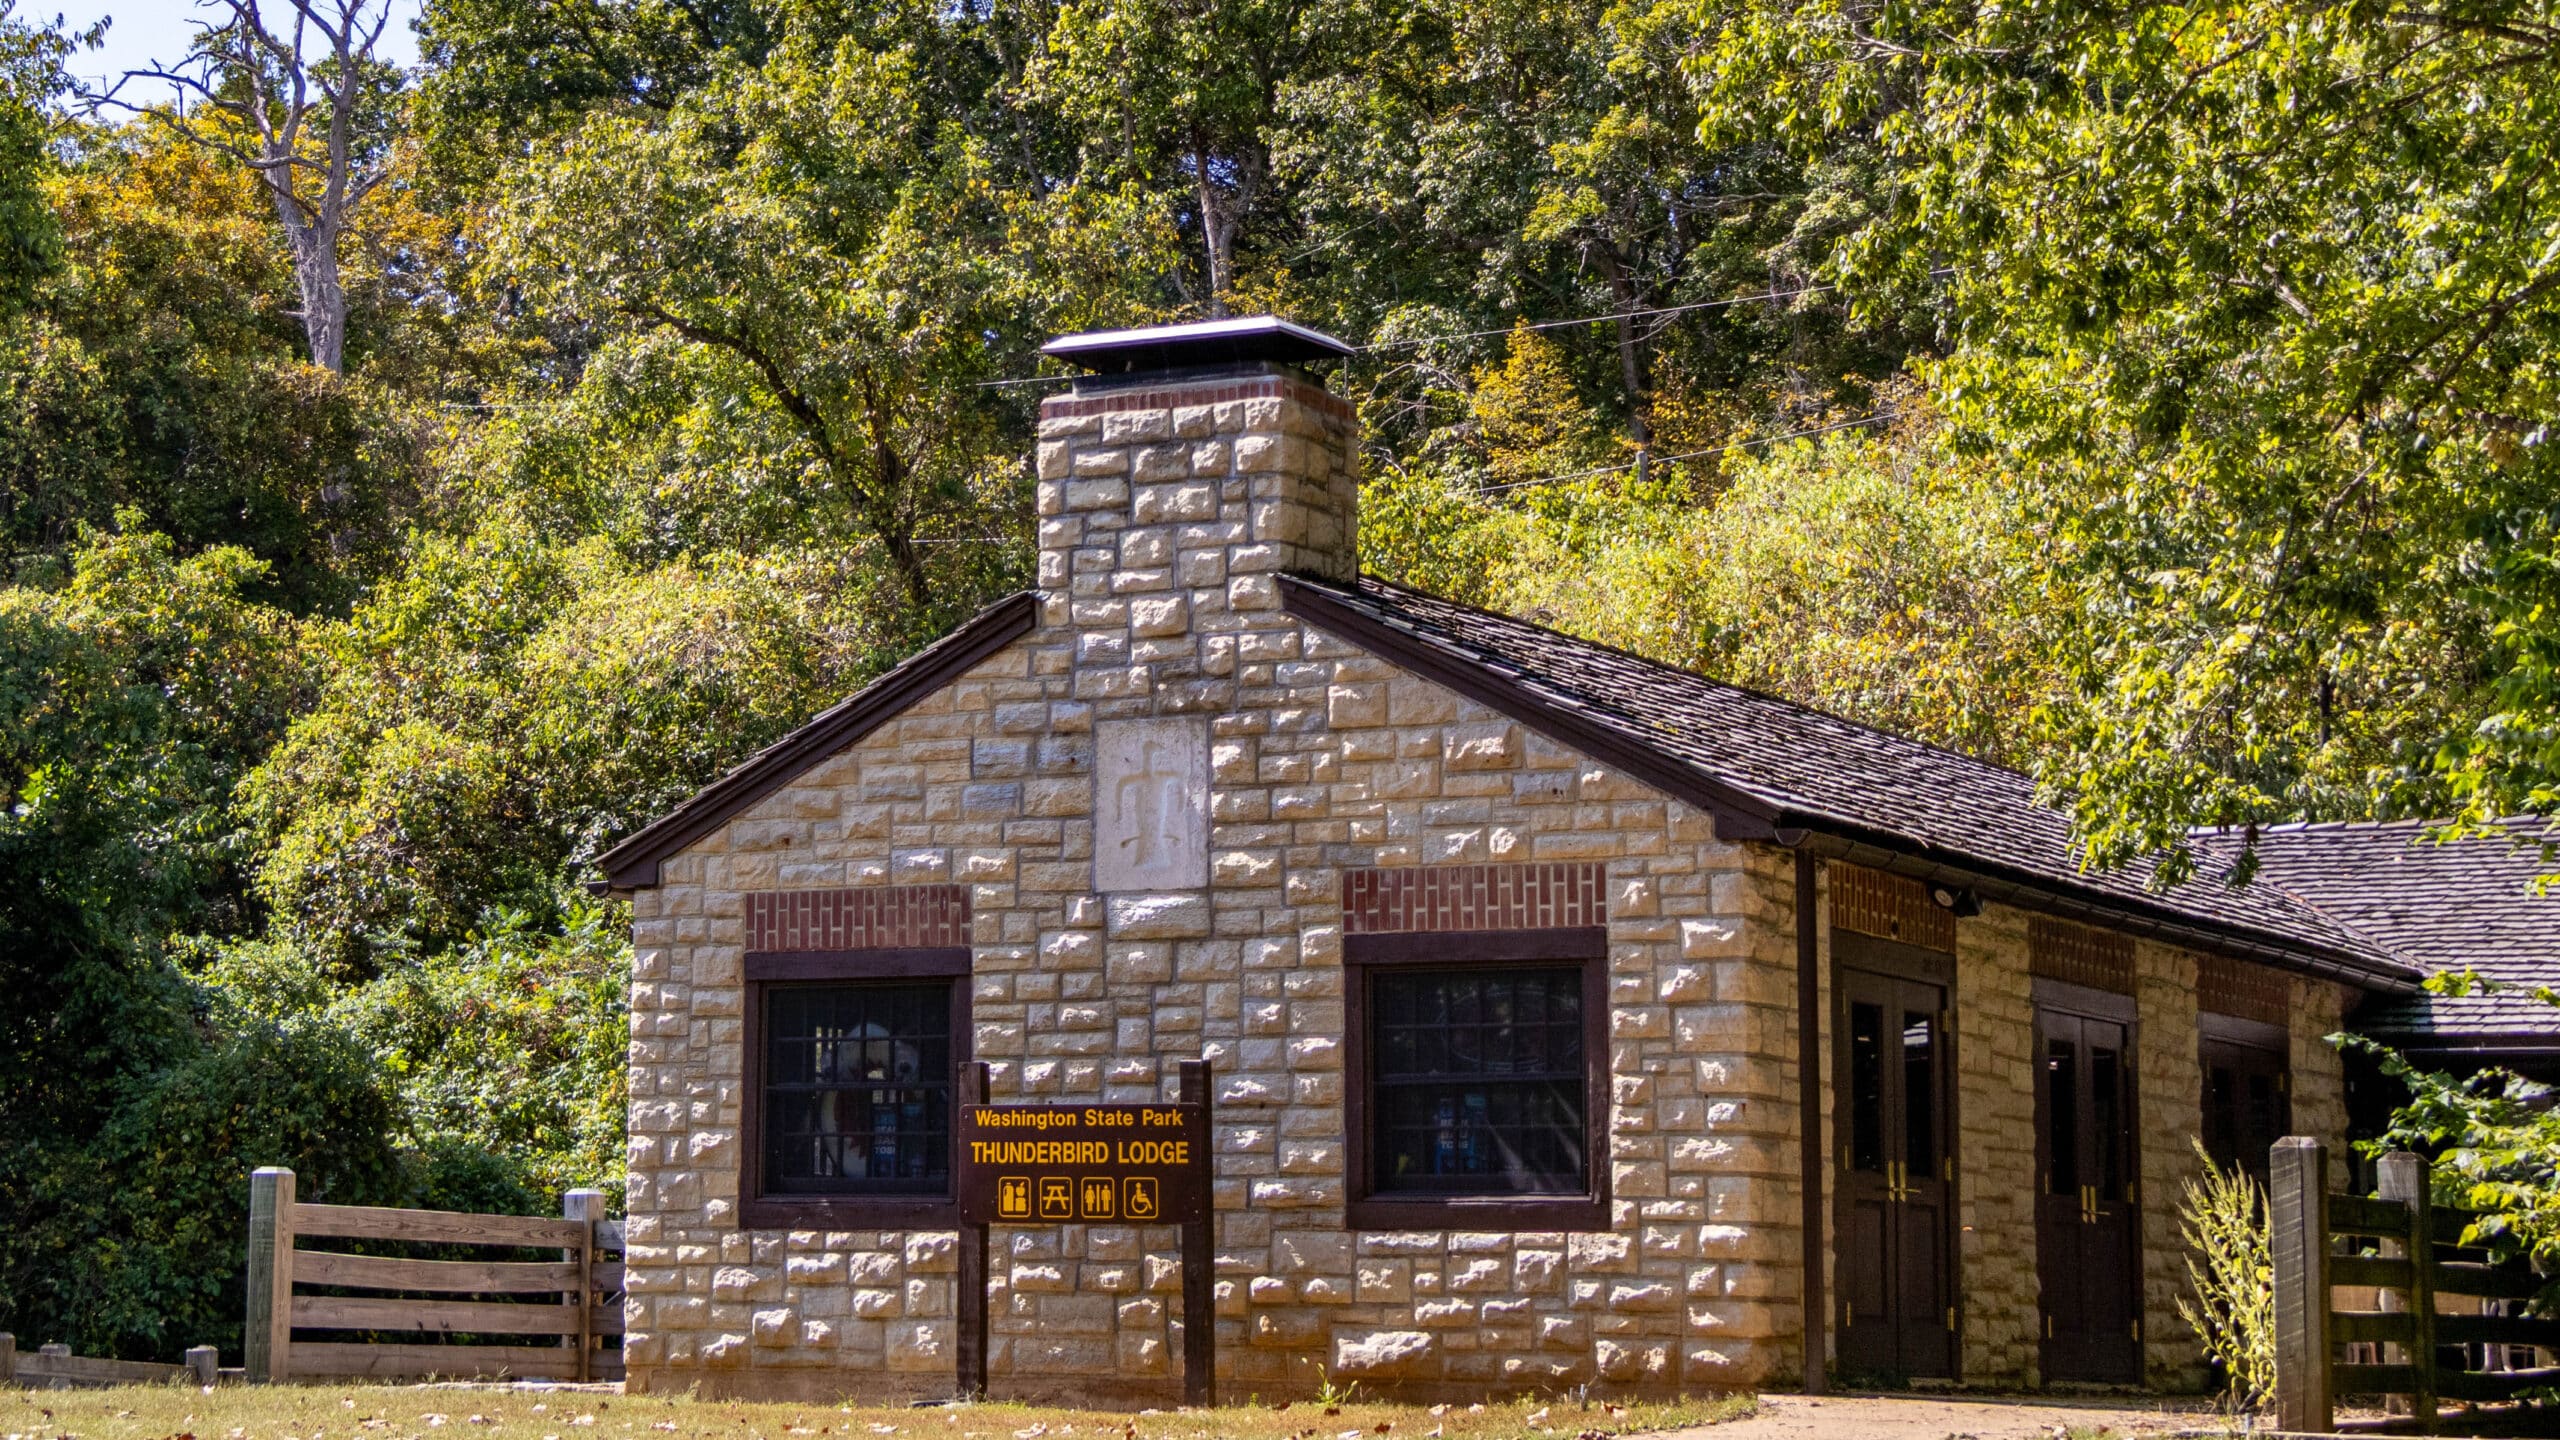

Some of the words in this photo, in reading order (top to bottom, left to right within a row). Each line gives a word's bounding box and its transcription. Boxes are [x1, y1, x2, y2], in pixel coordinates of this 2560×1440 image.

[974, 1109, 1076, 1130] Washington
[1084, 1109, 1133, 1127] State
[1142, 1109, 1183, 1127] Park
[971, 1141, 1109, 1164] THUNDERBIRD
[1117, 1141, 1188, 1164] LODGE
